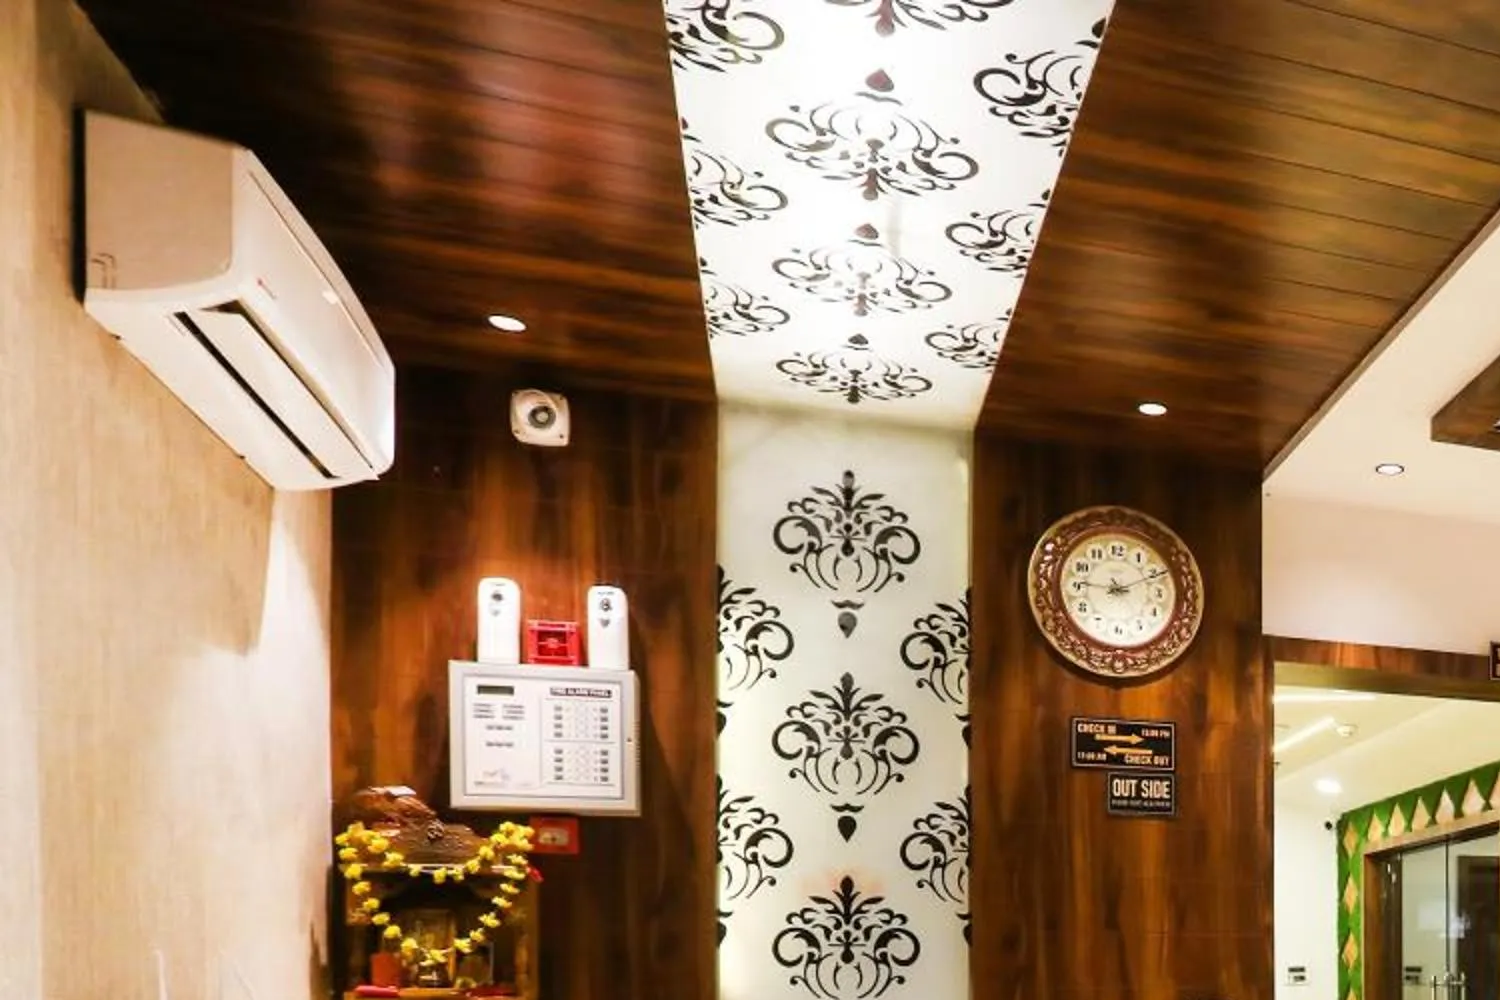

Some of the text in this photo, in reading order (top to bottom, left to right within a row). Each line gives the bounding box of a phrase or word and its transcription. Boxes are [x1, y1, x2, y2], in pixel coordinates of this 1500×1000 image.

[1091, 548, 1102, 559] 11
[1111, 545, 1124, 557] 12
[1076, 561, 1089, 573] 10
[1077, 723, 1105, 733] CHECK
[1124, 754, 1169, 766] CHECK OUT
[1113, 779, 1171, 799] OUT SIDE
